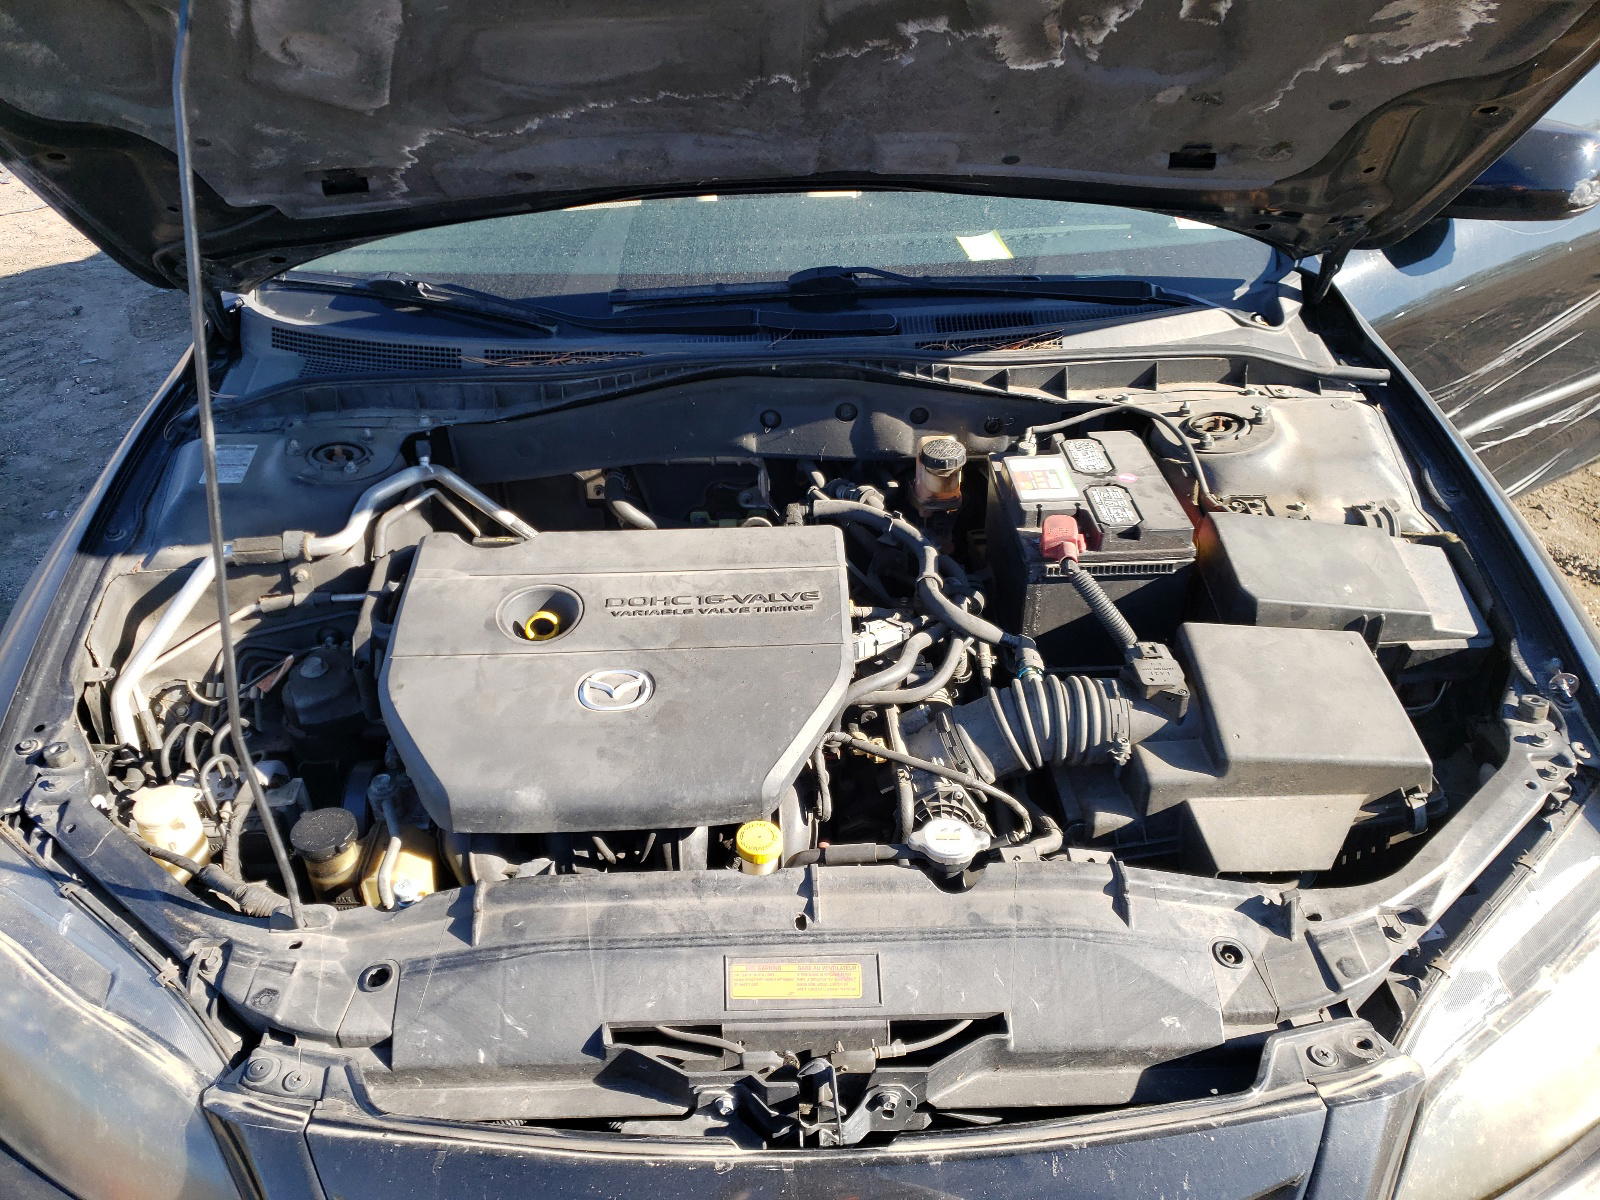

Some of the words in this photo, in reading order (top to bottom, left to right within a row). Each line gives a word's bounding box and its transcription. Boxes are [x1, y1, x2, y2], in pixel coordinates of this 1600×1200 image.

[605, 595, 692, 608] DOHC
[696, 590, 820, 606] 16-VALVE
[610, 607, 694, 617] VARIABLE
[697, 606, 750, 615] VALVE
[753, 604, 814, 614] TIMING
